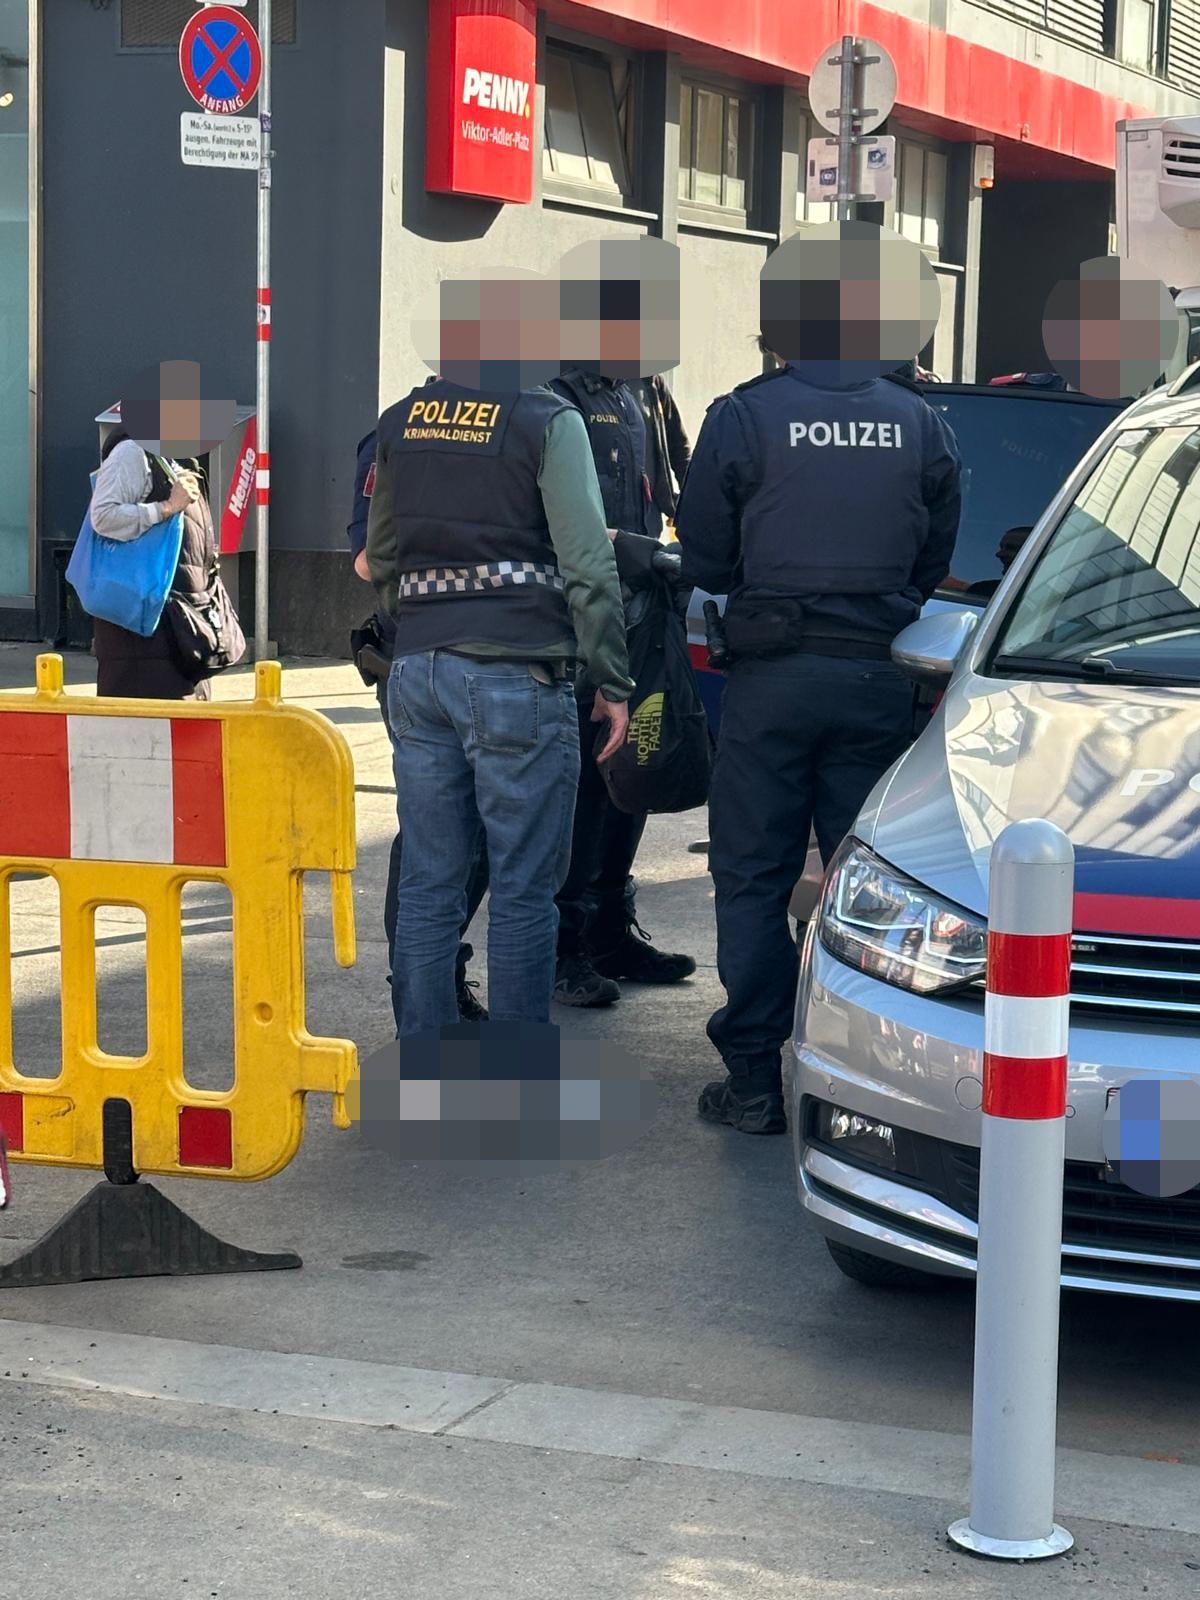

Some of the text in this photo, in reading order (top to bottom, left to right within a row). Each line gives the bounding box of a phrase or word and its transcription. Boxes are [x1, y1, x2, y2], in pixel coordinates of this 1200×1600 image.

[200, 94, 244, 112] ANFANG
[212, 135, 244, 147] Fahrzeuge
[246, 137, 257, 147] mit
[461, 120, 530, 152] Viktor-Adler-Platz
[184, 147, 226, 160] Berechtigung
[228, 151, 238, 159] der
[240, 151, 250, 161] MA
[407, 400, 501, 428] POLIZEI
[403, 427, 492, 444] KRIMINALDIENST
[789, 421, 902, 449] POLIZEI
[228, 447, 256, 518] Heute
[627, 719, 639, 744] THE
[637, 717, 650, 765] NORTH
[649, 717, 661, 751] FACE
[1119, 767, 1200, 797] P
